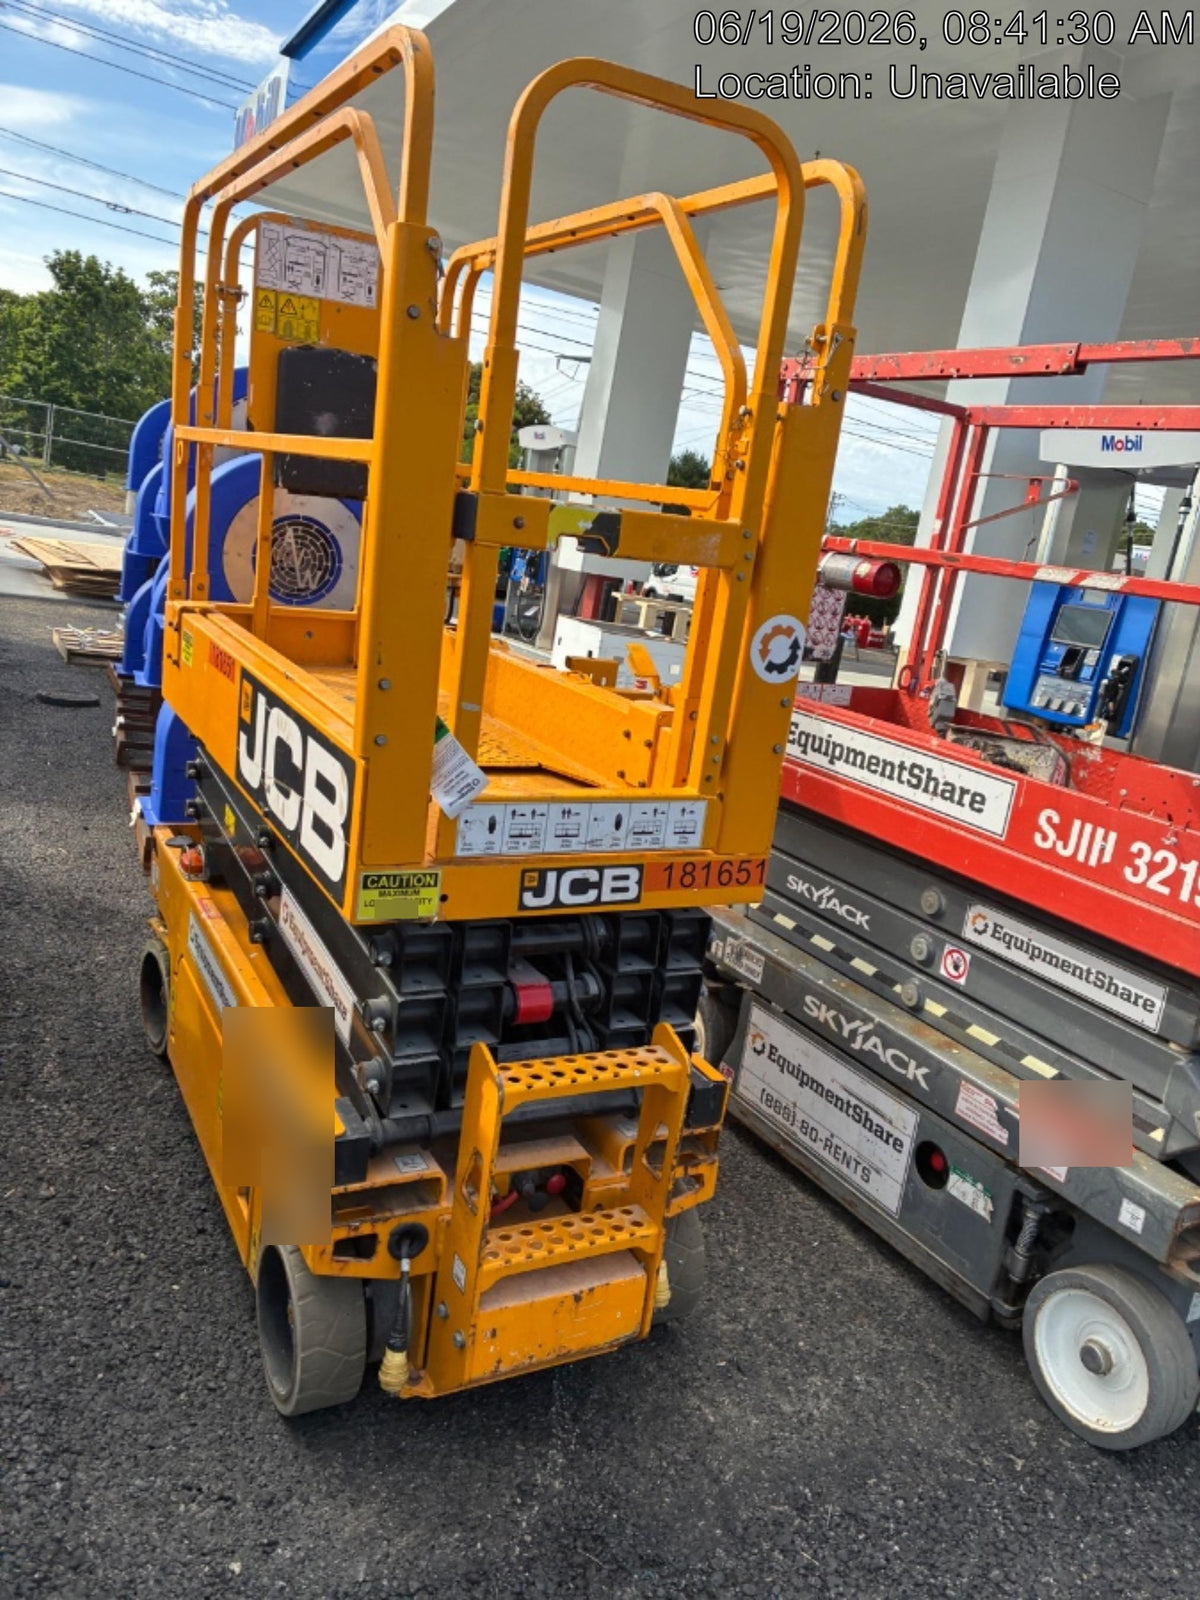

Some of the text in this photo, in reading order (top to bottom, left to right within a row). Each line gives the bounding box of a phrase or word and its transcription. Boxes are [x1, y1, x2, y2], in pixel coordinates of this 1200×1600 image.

[1101, 435, 1143, 452] Mobil
[239, 692, 349, 883] JCB
[367, 874, 436, 888] CAUTION
[522, 867, 640, 908] JCB
[663, 858, 766, 889] 181651
[1123, 841, 1200, 908] 321
[787, 875, 871, 931] SKYJACK
[990, 922, 1157, 1014] EquipmentShare
[803, 994, 931, 1092] SKYJACK
[760, 1088, 797, 1127] (888)
[767, 1043, 905, 1154] EquipmentShare
